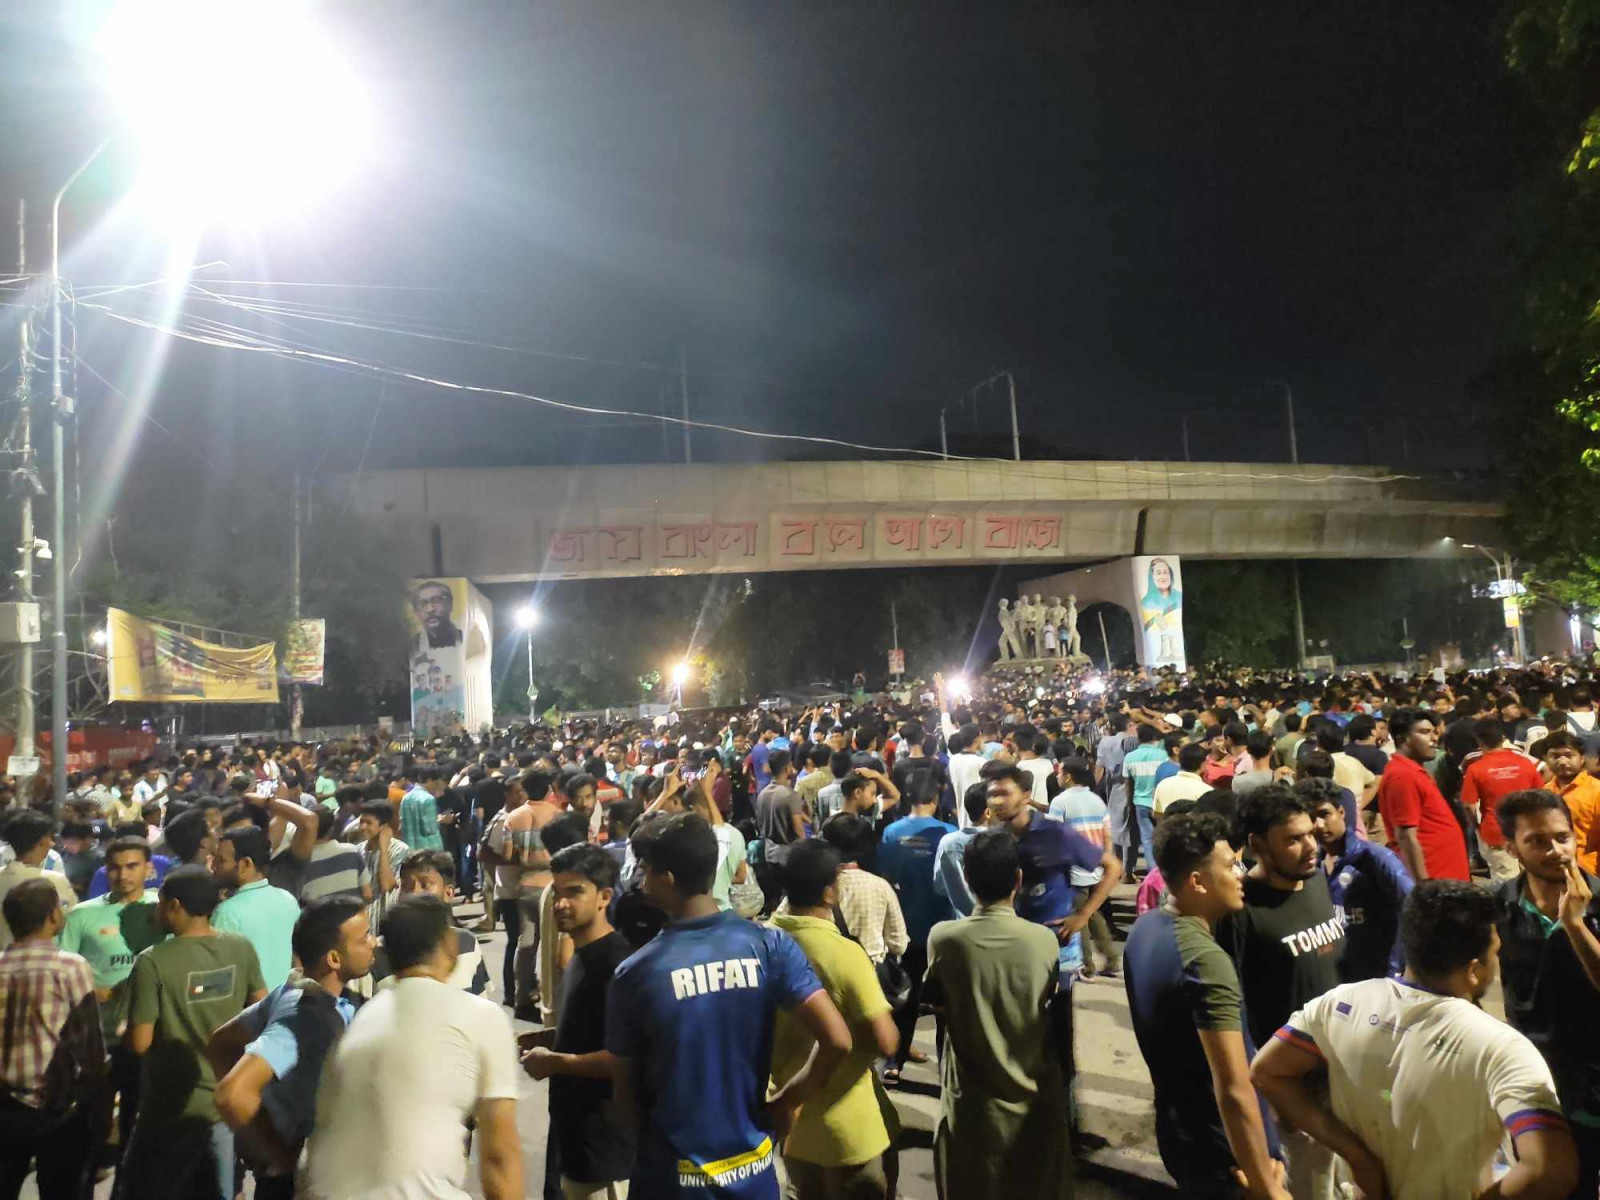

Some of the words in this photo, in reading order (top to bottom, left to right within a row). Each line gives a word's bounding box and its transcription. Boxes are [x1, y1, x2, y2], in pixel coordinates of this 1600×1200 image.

[661, 523, 757, 559] বাংলা
[781, 519, 866, 556] বলে
[671, 958, 760, 1000] RIFAT
